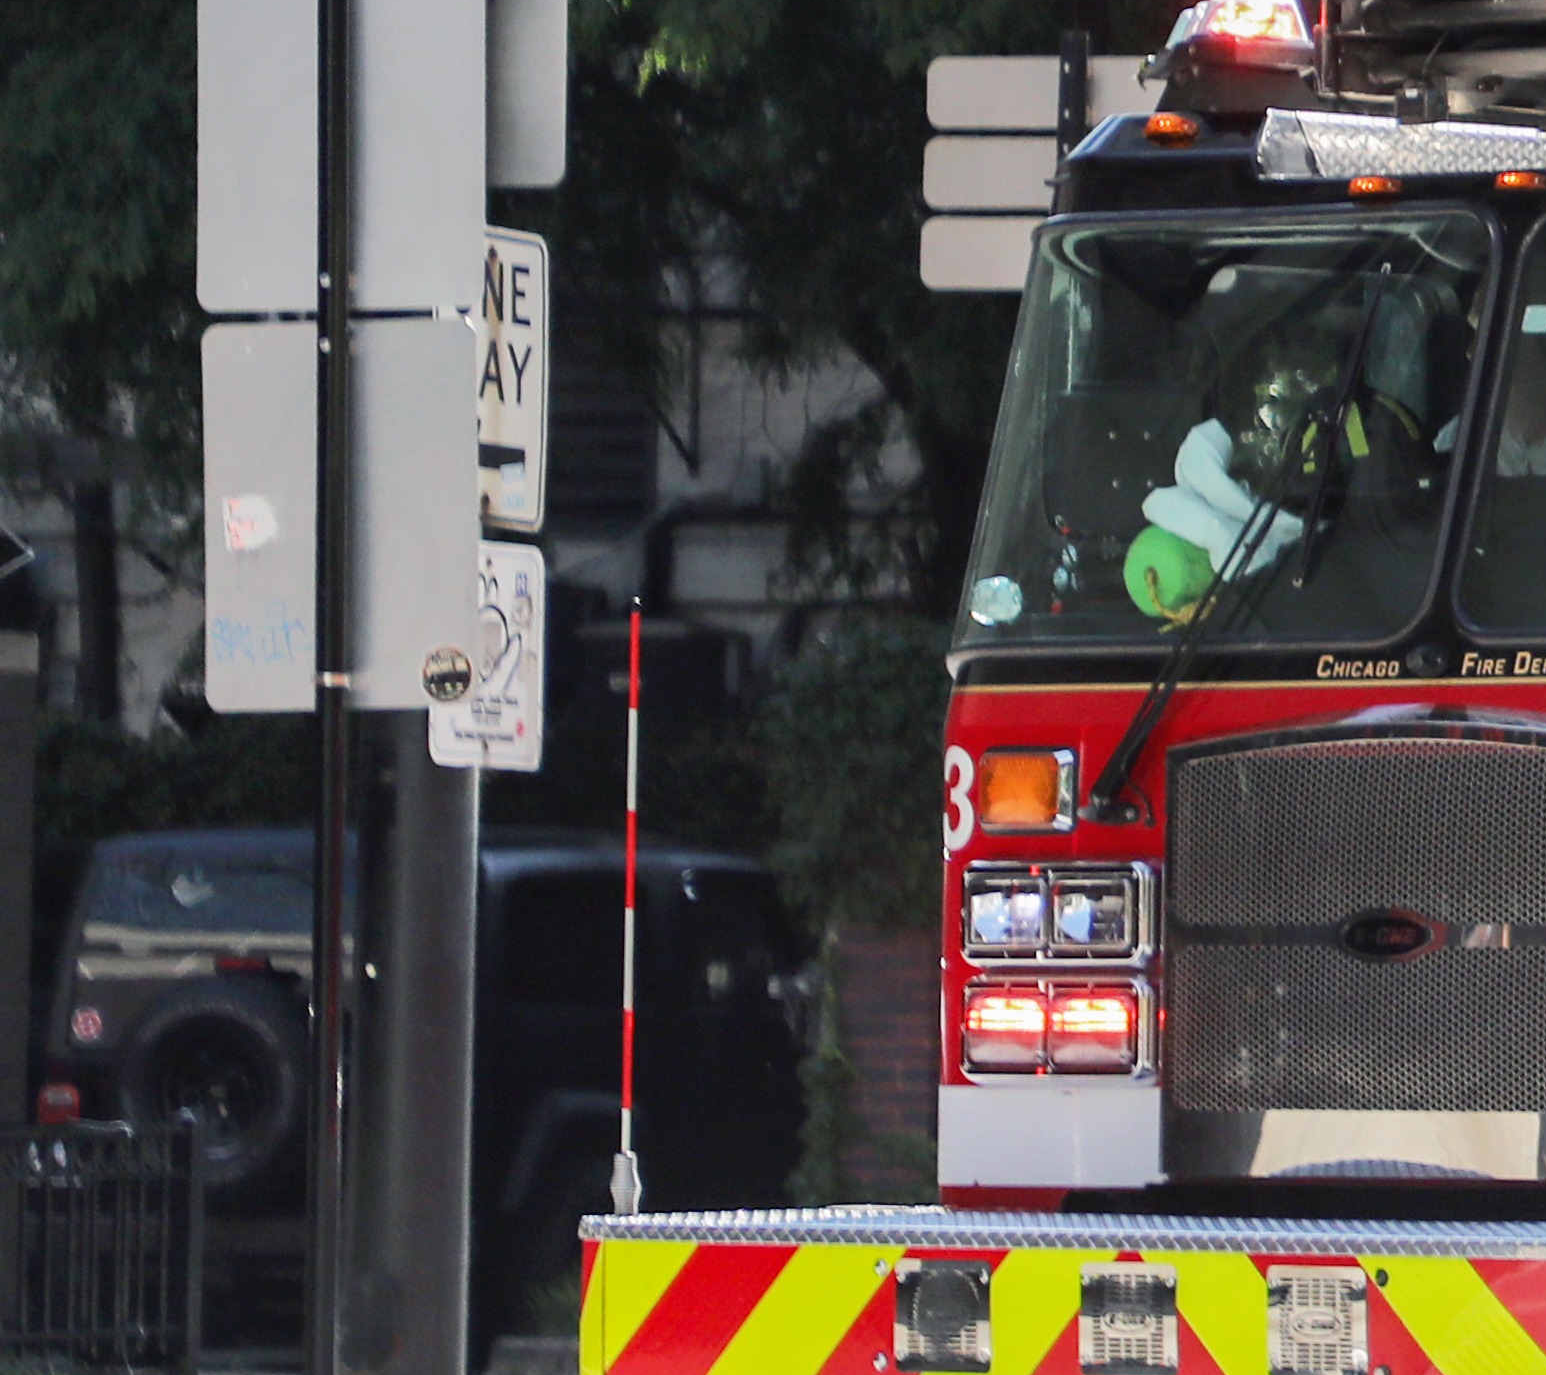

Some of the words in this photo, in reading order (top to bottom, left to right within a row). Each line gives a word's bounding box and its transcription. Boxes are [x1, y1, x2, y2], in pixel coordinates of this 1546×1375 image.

[482, 257, 531, 325] NE
[479, 339, 532, 405] AY
[943, 744, 975, 852] 3
